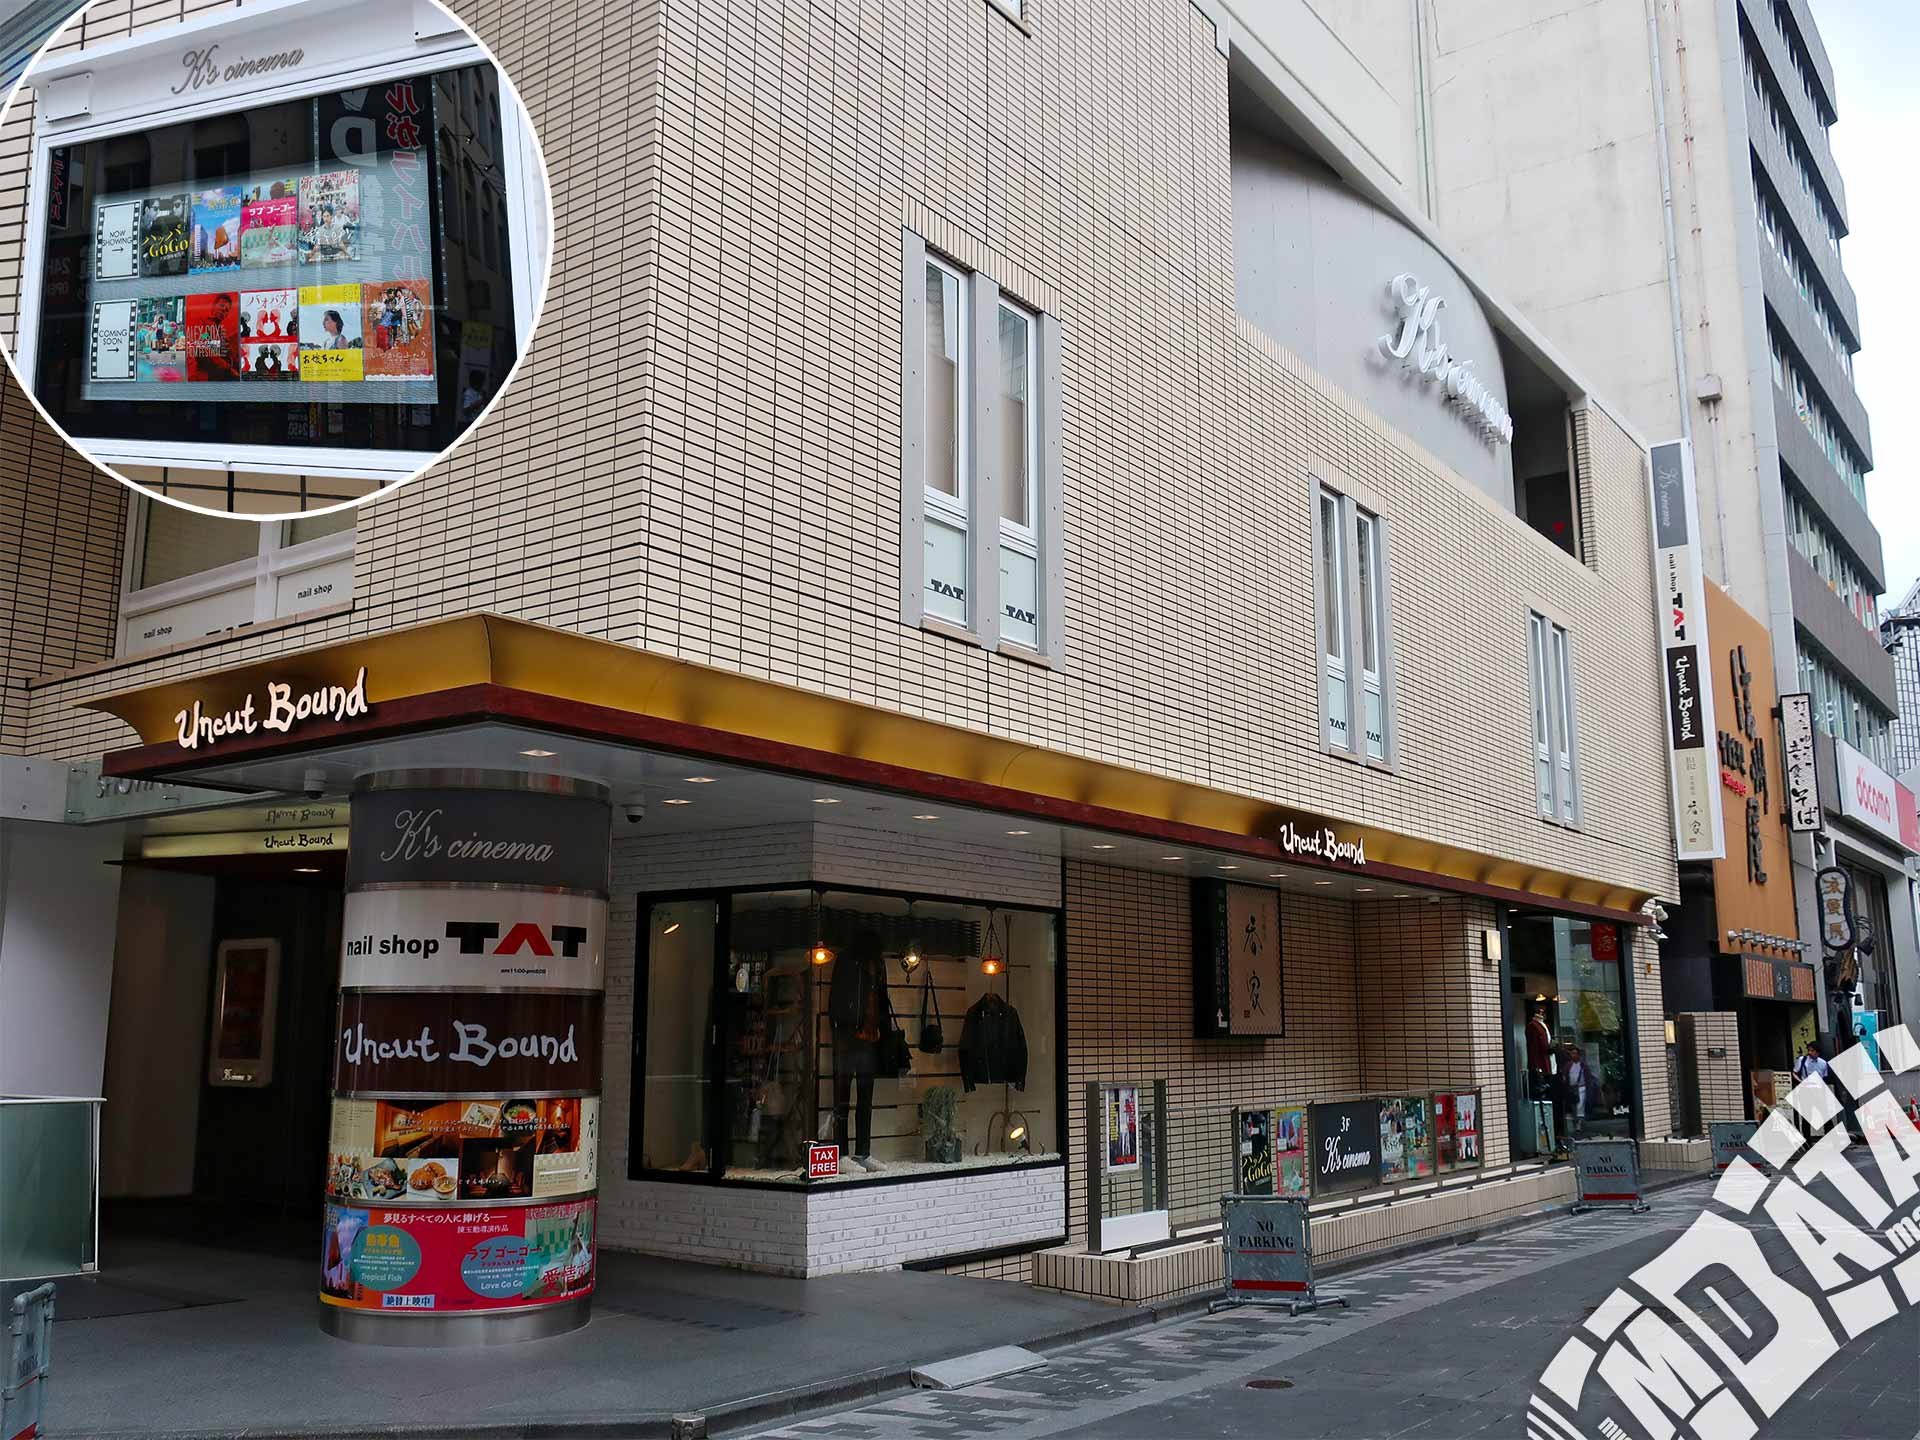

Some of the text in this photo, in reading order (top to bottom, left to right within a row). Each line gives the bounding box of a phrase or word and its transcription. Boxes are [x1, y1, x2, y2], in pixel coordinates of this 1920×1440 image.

[171, 44, 305, 95] K's cinema
[102, 236, 133, 247] SHOWING
[109, 230, 126, 239] NOW
[99, 328, 128, 338] COMING
[1377, 272, 1448, 383] K's
[102, 337, 123, 346] SOON
[931, 578, 965, 601] TAT
[1669, 571, 1677, 593] shop
[297, 583, 334, 600] nail shop
[1005, 604, 1036, 624] TAT
[1672, 592, 1686, 641] TAT
[143, 625, 173, 640] nail shop
[1675, 655, 1691, 695] Uncut
[174, 666, 368, 749] Uncut Bound
[1678, 696, 1696, 741] Bound
[1855, 766, 1892, 825] docomo
[264, 832, 334, 850] Uncut Bound
[380, 808, 554, 862] K's cinema
[1280, 821, 1366, 865] Uncut Bound
[346, 921, 587, 959] nail shop TAT
[343, 1019, 578, 1068] Uncut Bound
[1340, 1115, 1351, 1133] 3F
[814, 1150, 834, 1163] TAX
[1321, 1135, 1371, 1174] K's cinema
[1599, 1155, 1613, 1163] NO
[811, 1162, 838, 1174] FREE
[1586, 1165, 1627, 1174] PARKING
[1256, 1220, 1275, 1234] NO
[1238, 1233, 1295, 1250] PARKING
[386, 1273, 403, 1283] Fish
[480, 1281, 500, 1291] Love
